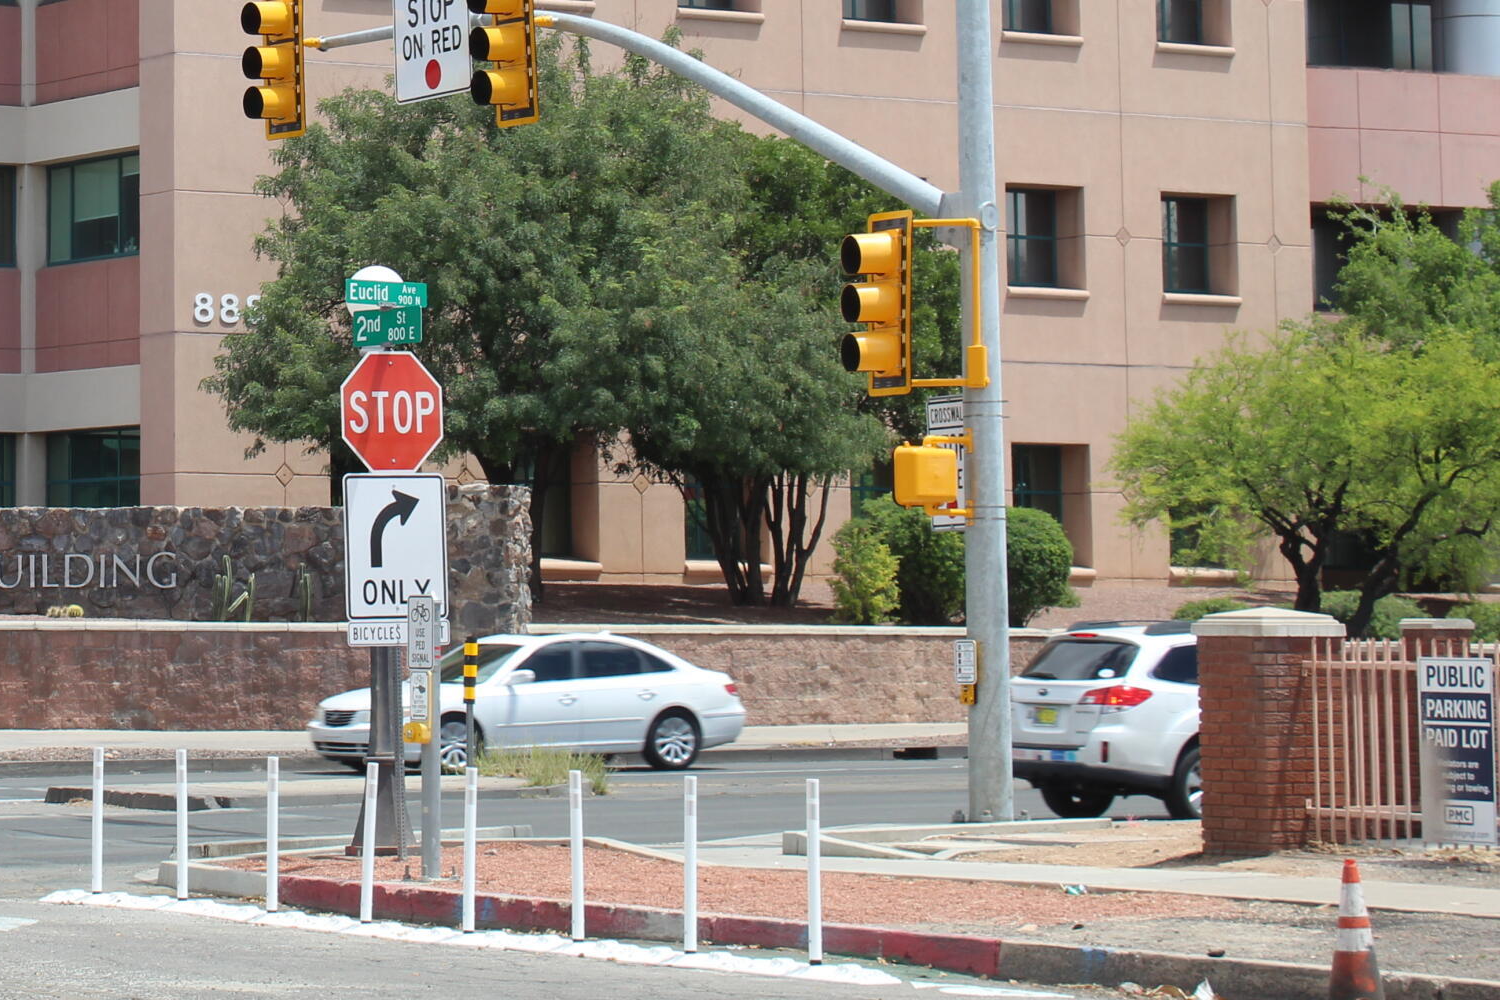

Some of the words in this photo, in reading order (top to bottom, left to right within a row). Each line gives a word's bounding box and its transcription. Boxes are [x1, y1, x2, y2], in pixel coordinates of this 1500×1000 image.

[402, 33, 423, 61] ON
[431, 25, 462, 55] RED
[349, 282, 389, 301] Euclid
[402, 284, 417, 294] Ave
[398, 296, 413, 305] 900
[415, 296, 421, 305] N
[356, 315, 381, 342] 2nd
[396, 311, 406, 324] St
[388, 327, 405, 341] 800
[409, 326, 415, 340] E
[349, 390, 435, 434] STOP
[930, 406, 963, 424] CROSSWAL
[363, 579, 431, 605] ONLY
[353, 626, 401, 640] BICYCLES
[415, 628, 425, 637] USE
[415, 640, 425, 650] PED
[412, 653, 430, 663] SIGNAL
[1426, 665, 1485, 688] PUBLIC
[1426, 698, 1487, 720] PARKING
[1426, 727, 1458, 748] PAID
[1462, 729, 1488, 749] LOT
[1449, 809, 1470, 821] PMC
